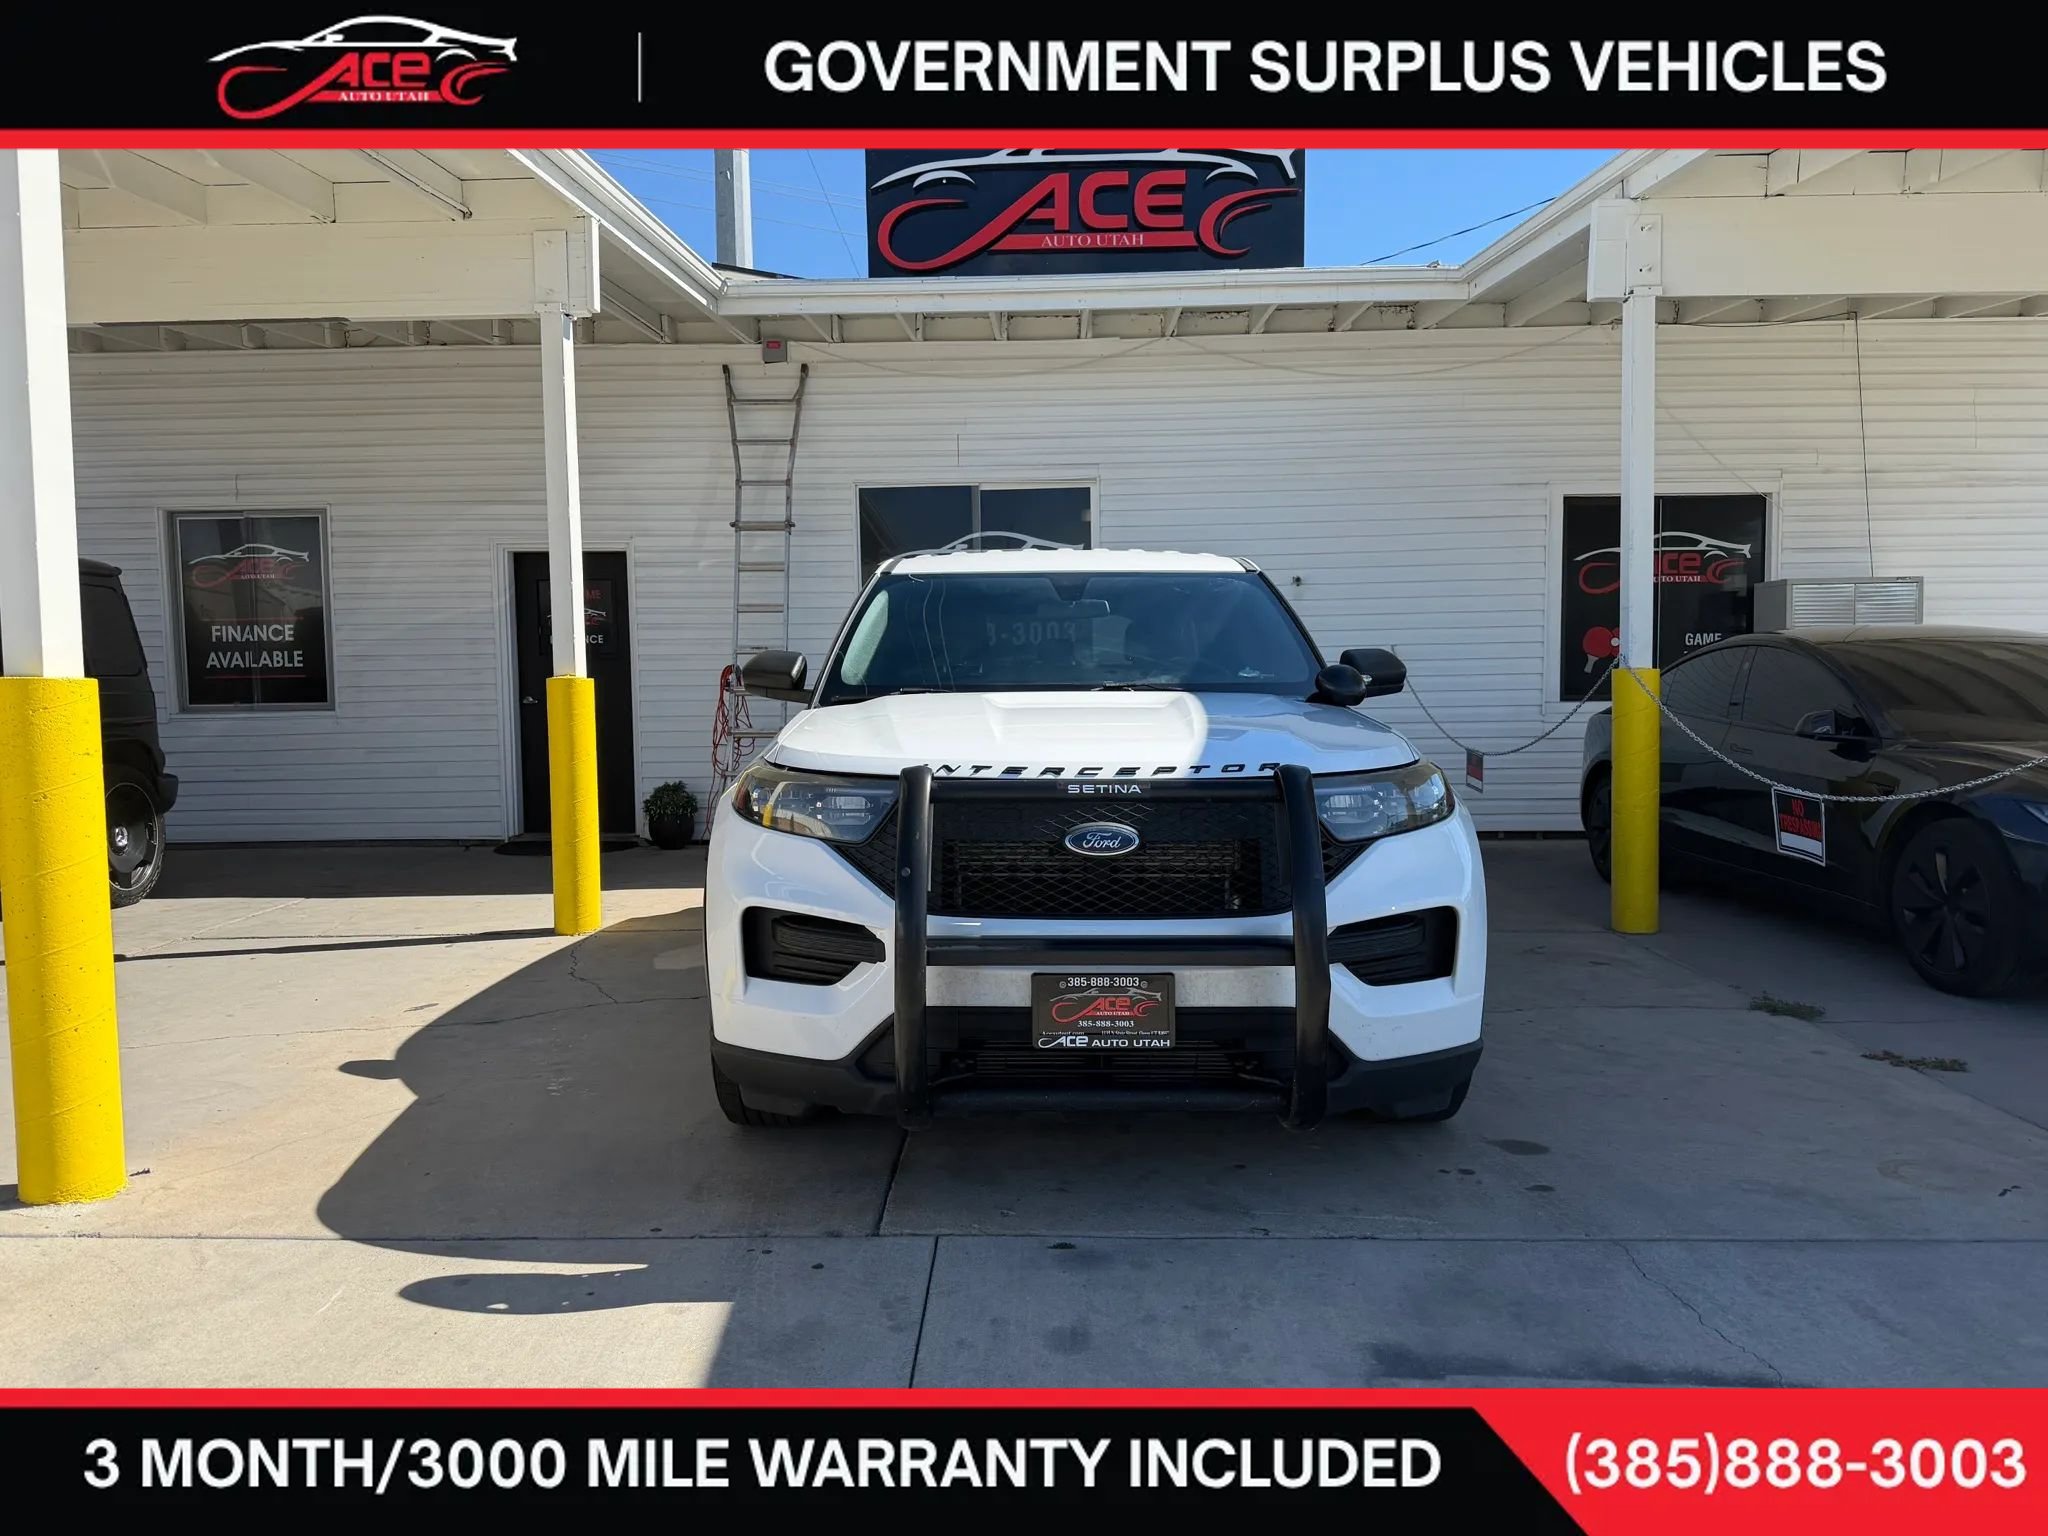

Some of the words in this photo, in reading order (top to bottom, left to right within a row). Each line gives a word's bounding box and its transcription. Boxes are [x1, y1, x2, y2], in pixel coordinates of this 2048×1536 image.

[1041, 234, 1092, 248] AUTO
[1095, 232, 1145, 247] UTAH
[211, 624, 295, 642] FINANCE
[206, 650, 304, 669] AVAILABLE
[924, 762, 1281, 777] NTERCEPTOR
[1067, 784, 1142, 794] SETINA
[1791, 798, 1805, 817] NO
[1082, 831, 1122, 848] Ford
[1067, 977, 1139, 987] 385-888-3003
[1077, 1020, 1134, 1028] 385-888-3003
[1092, 1039, 1129, 1047] AUTO
[1133, 1039, 1170, 1047] UTAH
